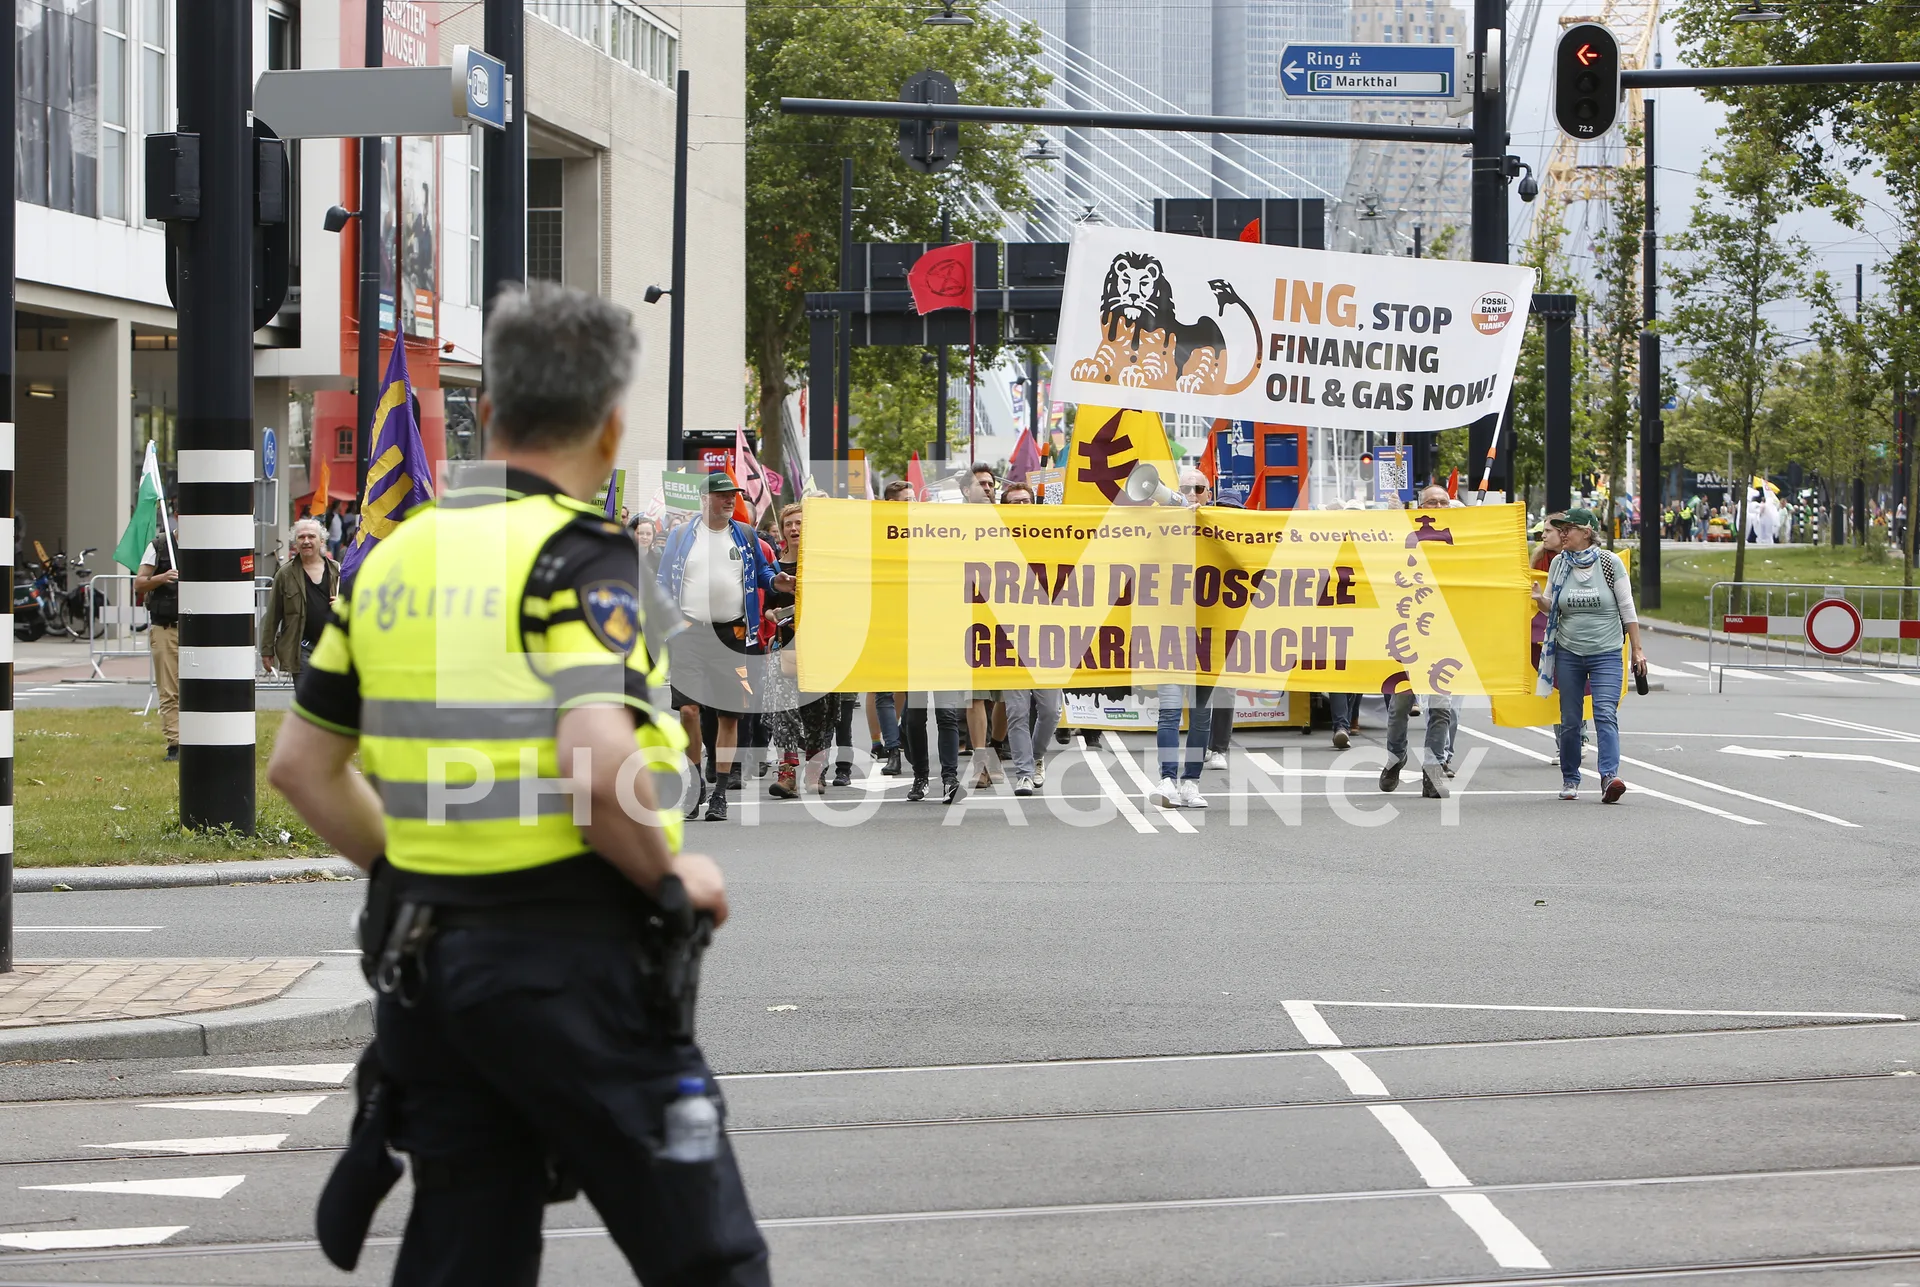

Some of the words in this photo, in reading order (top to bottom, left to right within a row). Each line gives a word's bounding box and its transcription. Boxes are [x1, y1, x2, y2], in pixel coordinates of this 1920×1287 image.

[1307, 51, 1344, 69] Ring
[1336, 75, 1397, 87] Markthal
[1578, 124, 1594, 133] 72.2
[1272, 278, 1363, 331] ING,
[1373, 302, 1452, 334] STOP
[1481, 297, 1508, 305] FOSSIL
[1478, 321, 1506, 331] THANKS
[1487, 314, 1499, 322] NO
[1269, 332, 1440, 374] FINANCING
[1265, 373, 1316, 405] OIL
[1321, 378, 1346, 408] &
[1352, 380, 1414, 411] GAS
[1422, 373, 1498, 412] NOW!
[887, 524, 967, 540] Banken,
[975, 524, 1152, 541] pensioenfondsen,
[1158, 524, 1284, 544] verzekeraars
[1290, 529, 1304, 543] &
[1309, 529, 1394, 543] overheid:
[963, 561, 1095, 608] DRAAI
[1107, 563, 1159, 607] DE
[1170, 564, 1356, 609] FOSSIELE
[964, 622, 1213, 672] GELDKRAAN
[1224, 626, 1354, 674] DICHT
